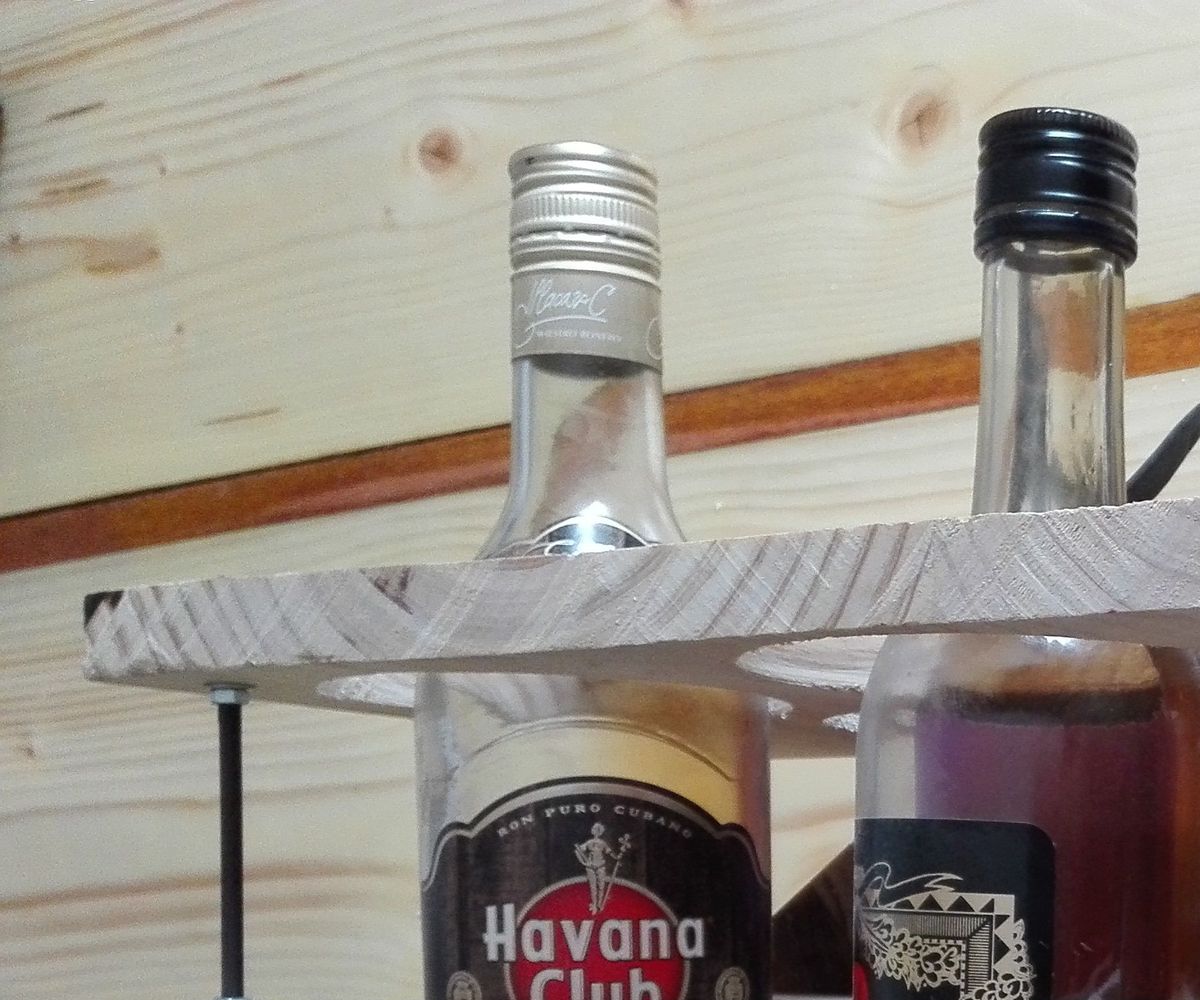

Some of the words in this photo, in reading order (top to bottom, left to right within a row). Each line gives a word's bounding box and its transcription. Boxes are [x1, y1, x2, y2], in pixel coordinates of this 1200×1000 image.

[496, 813, 535, 838] RON
[544, 803, 601, 818] PURO
[613, 804, 693, 839] CUBANO
[483, 902, 705, 963] Havana
